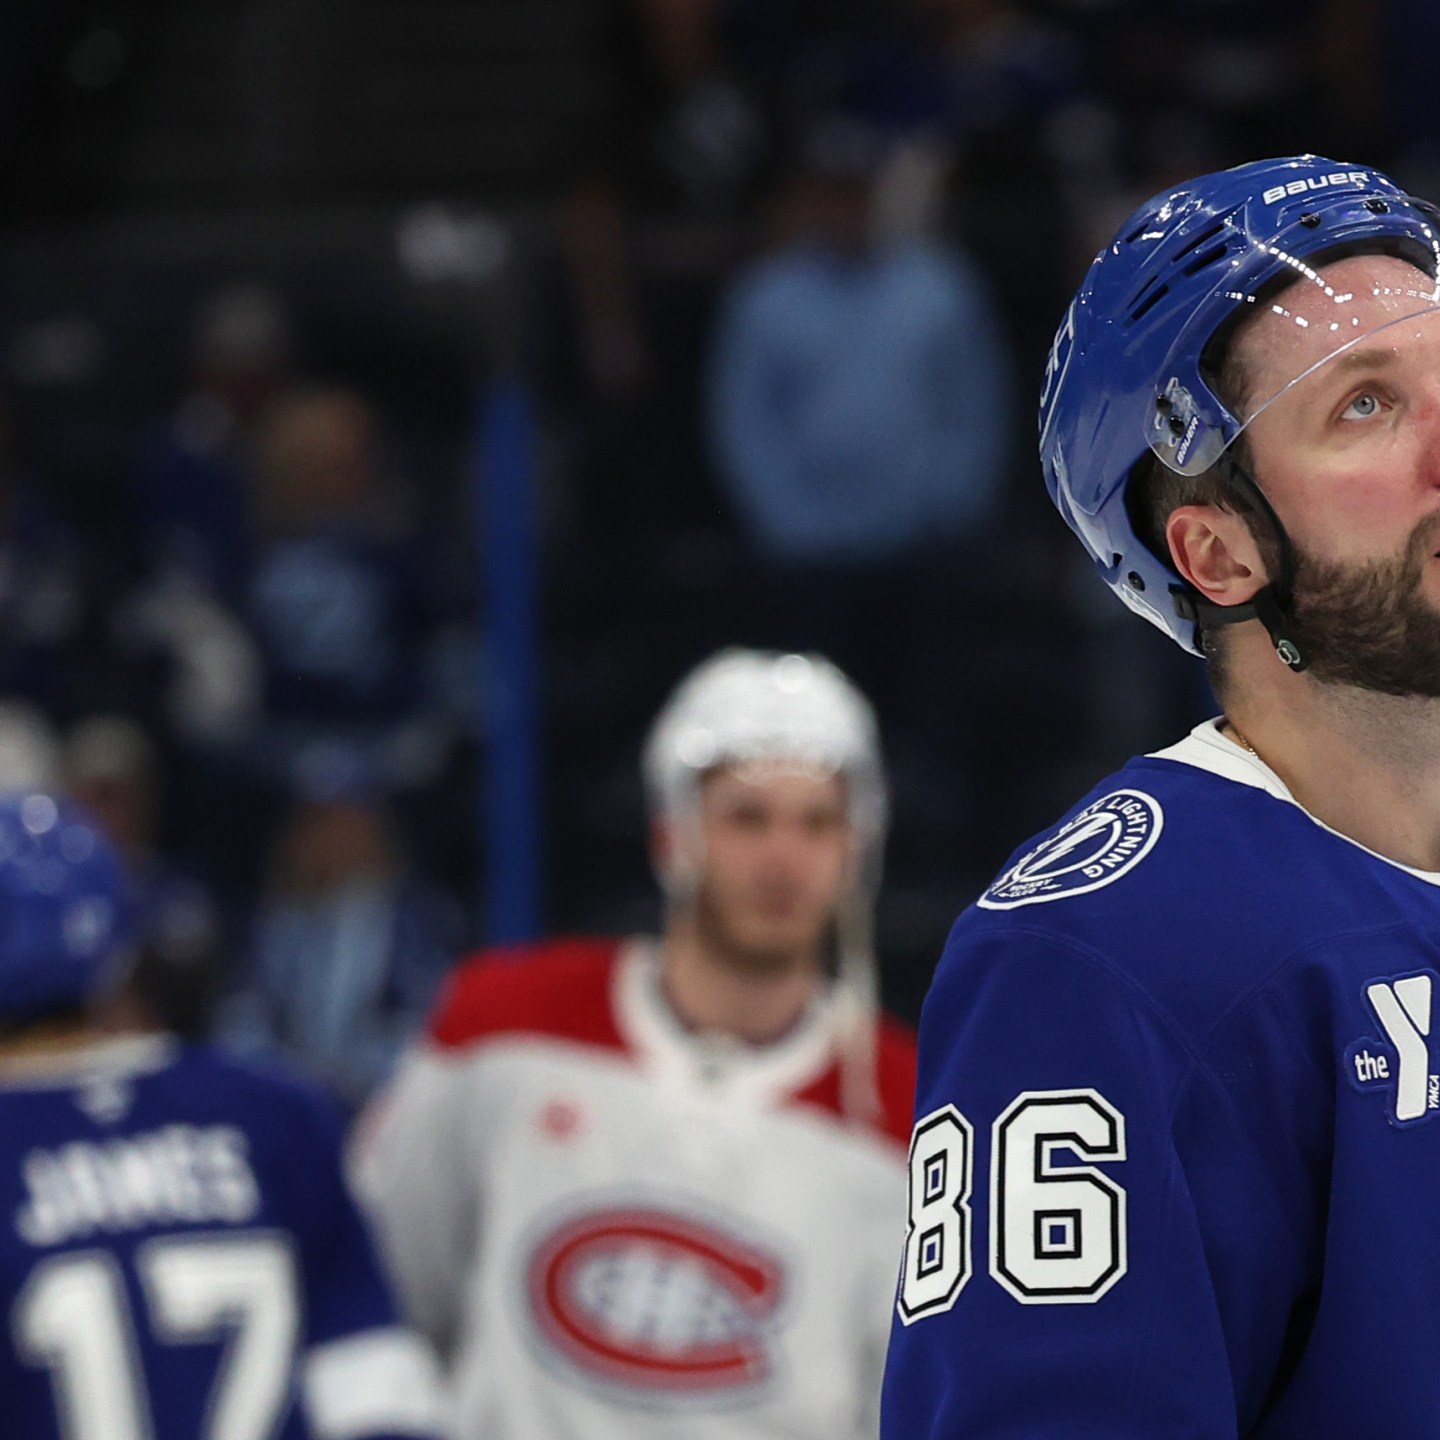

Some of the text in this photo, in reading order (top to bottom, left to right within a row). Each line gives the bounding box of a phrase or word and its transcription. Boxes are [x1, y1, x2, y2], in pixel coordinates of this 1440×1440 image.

[1082, 797, 1148, 878] LIGHTNING
[1354, 975, 1431, 1120] the Y
[1428, 1075, 1440, 1109] YMCA
[897, 1087, 1127, 1326] 86
